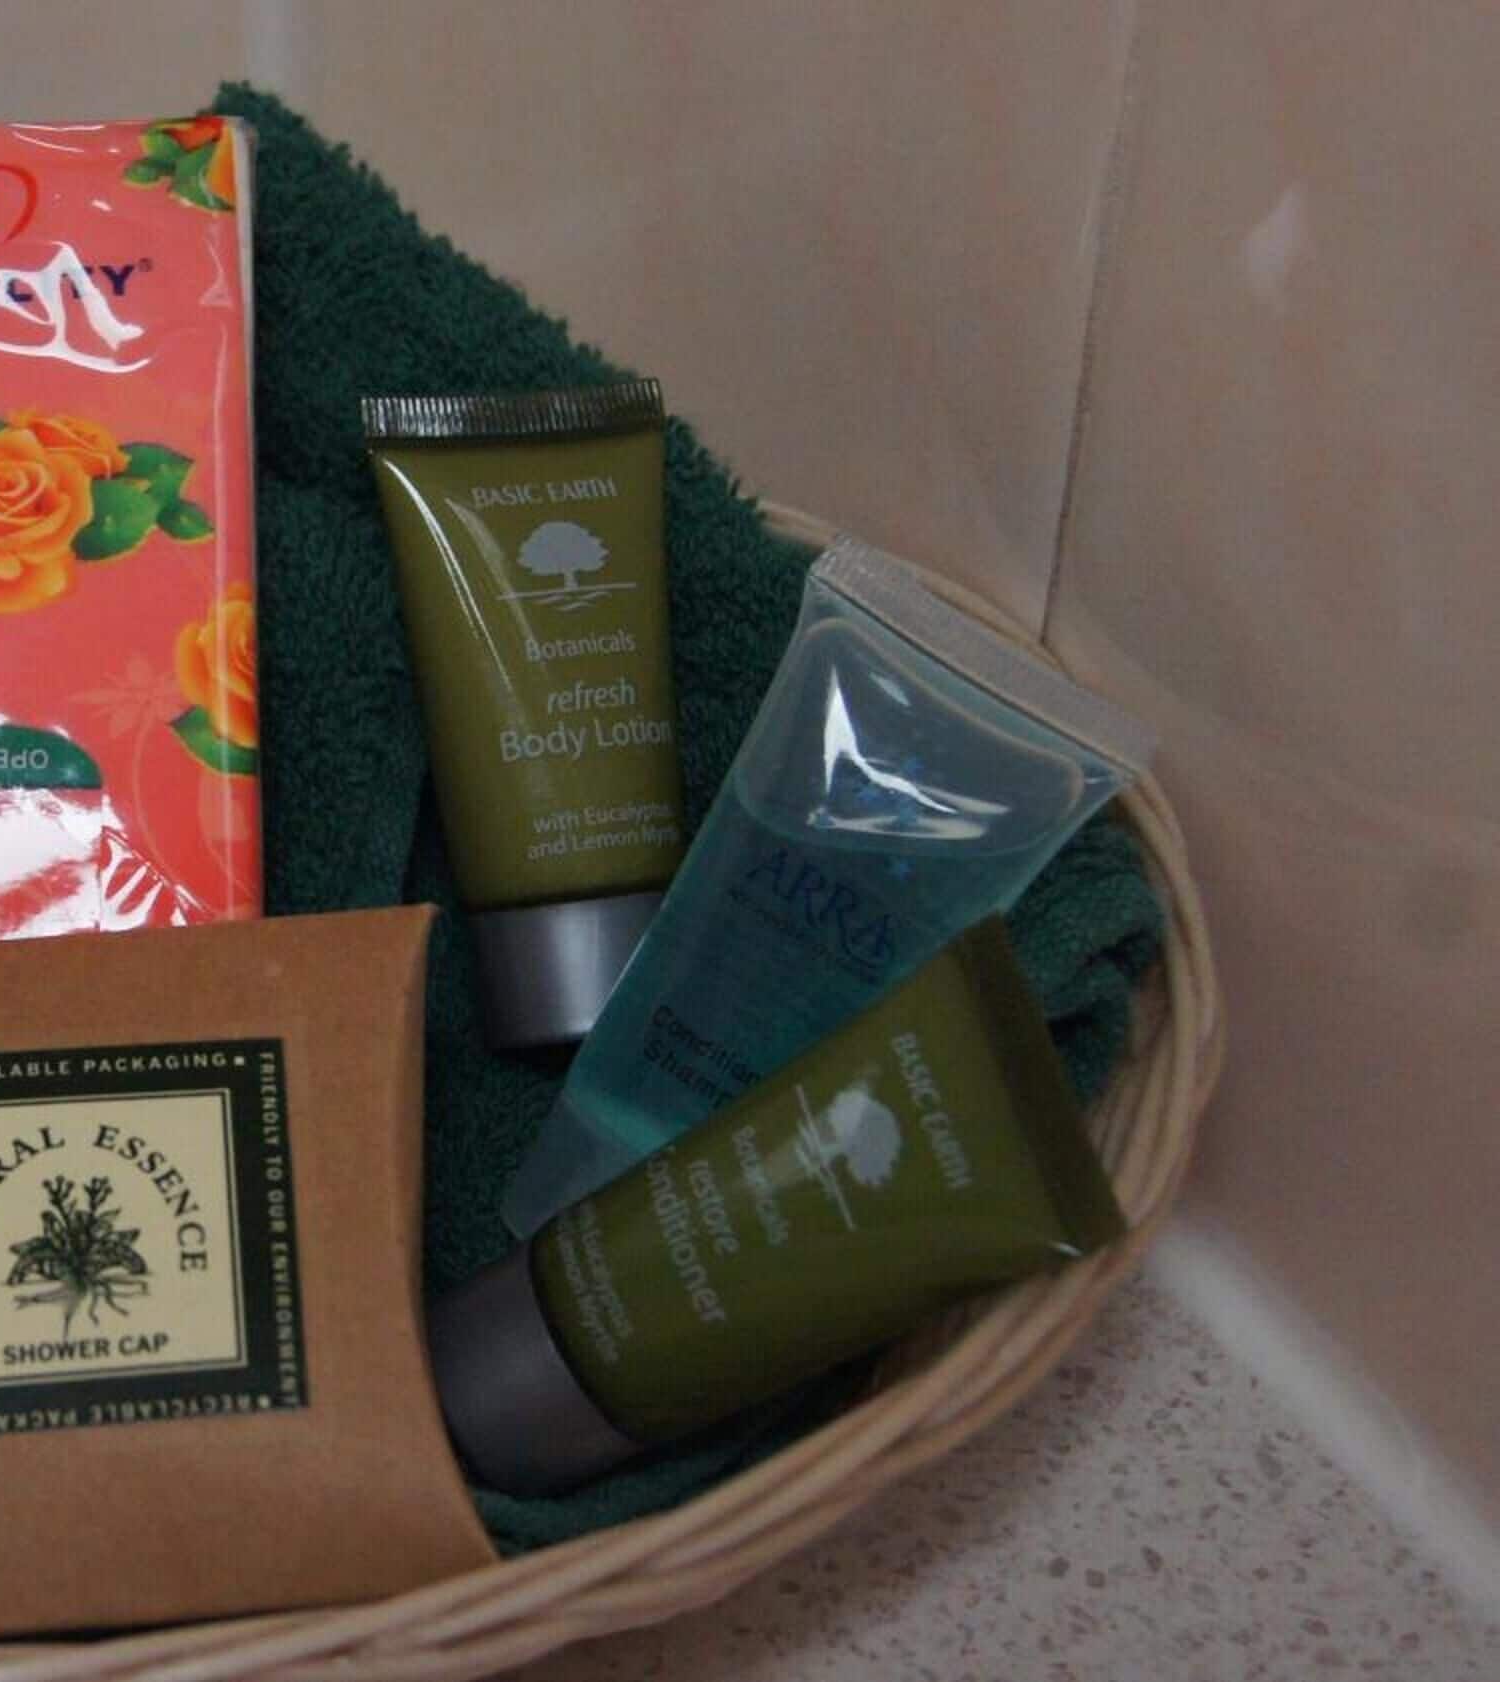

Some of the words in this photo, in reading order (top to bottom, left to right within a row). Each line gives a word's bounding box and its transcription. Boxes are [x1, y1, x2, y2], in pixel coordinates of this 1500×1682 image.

[472, 482, 543, 510] BASIC
[547, 476, 618, 502] EARTH
[524, 629, 636, 662] Botanicals
[547, 676, 636, 715] refresh
[500, 723, 587, 763] Body
[84, 1052, 228, 1074] PACKAGING
[259, 1051, 283, 1147] FRIENDLY
[264, 1154, 283, 1182] TO
[92, 1124, 208, 1274] ESSENCE
[268, 1190, 286, 1235] OUR
[688, 1159, 741, 1257] restore
[645, 1151, 727, 1322] onditioner
[2, 1336, 111, 1365] SHOWER
[118, 1333, 168, 1357] CAP
